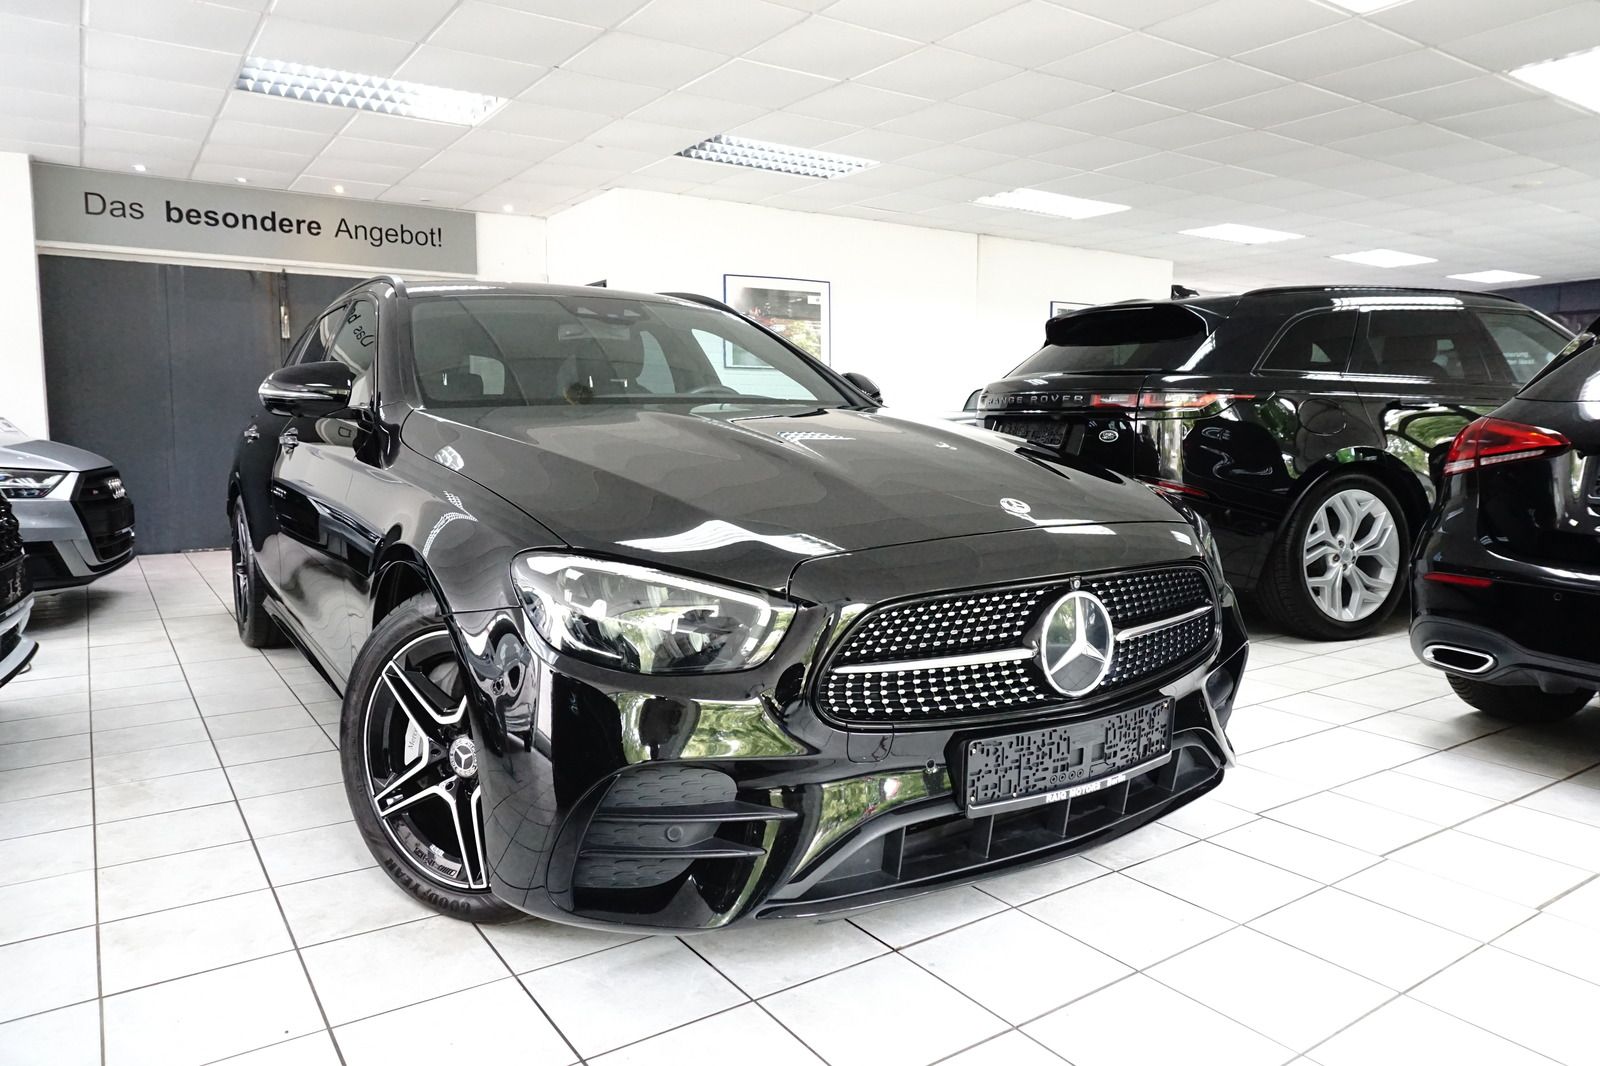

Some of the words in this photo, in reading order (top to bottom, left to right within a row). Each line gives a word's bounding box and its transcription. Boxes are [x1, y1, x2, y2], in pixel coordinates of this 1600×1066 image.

[83, 191, 145, 220] Das
[165, 200, 322, 236] besondere
[334, 217, 443, 248] Angebot!
[987, 395, 1023, 405] RANGE
[1030, 394, 1084, 405] ROVER
